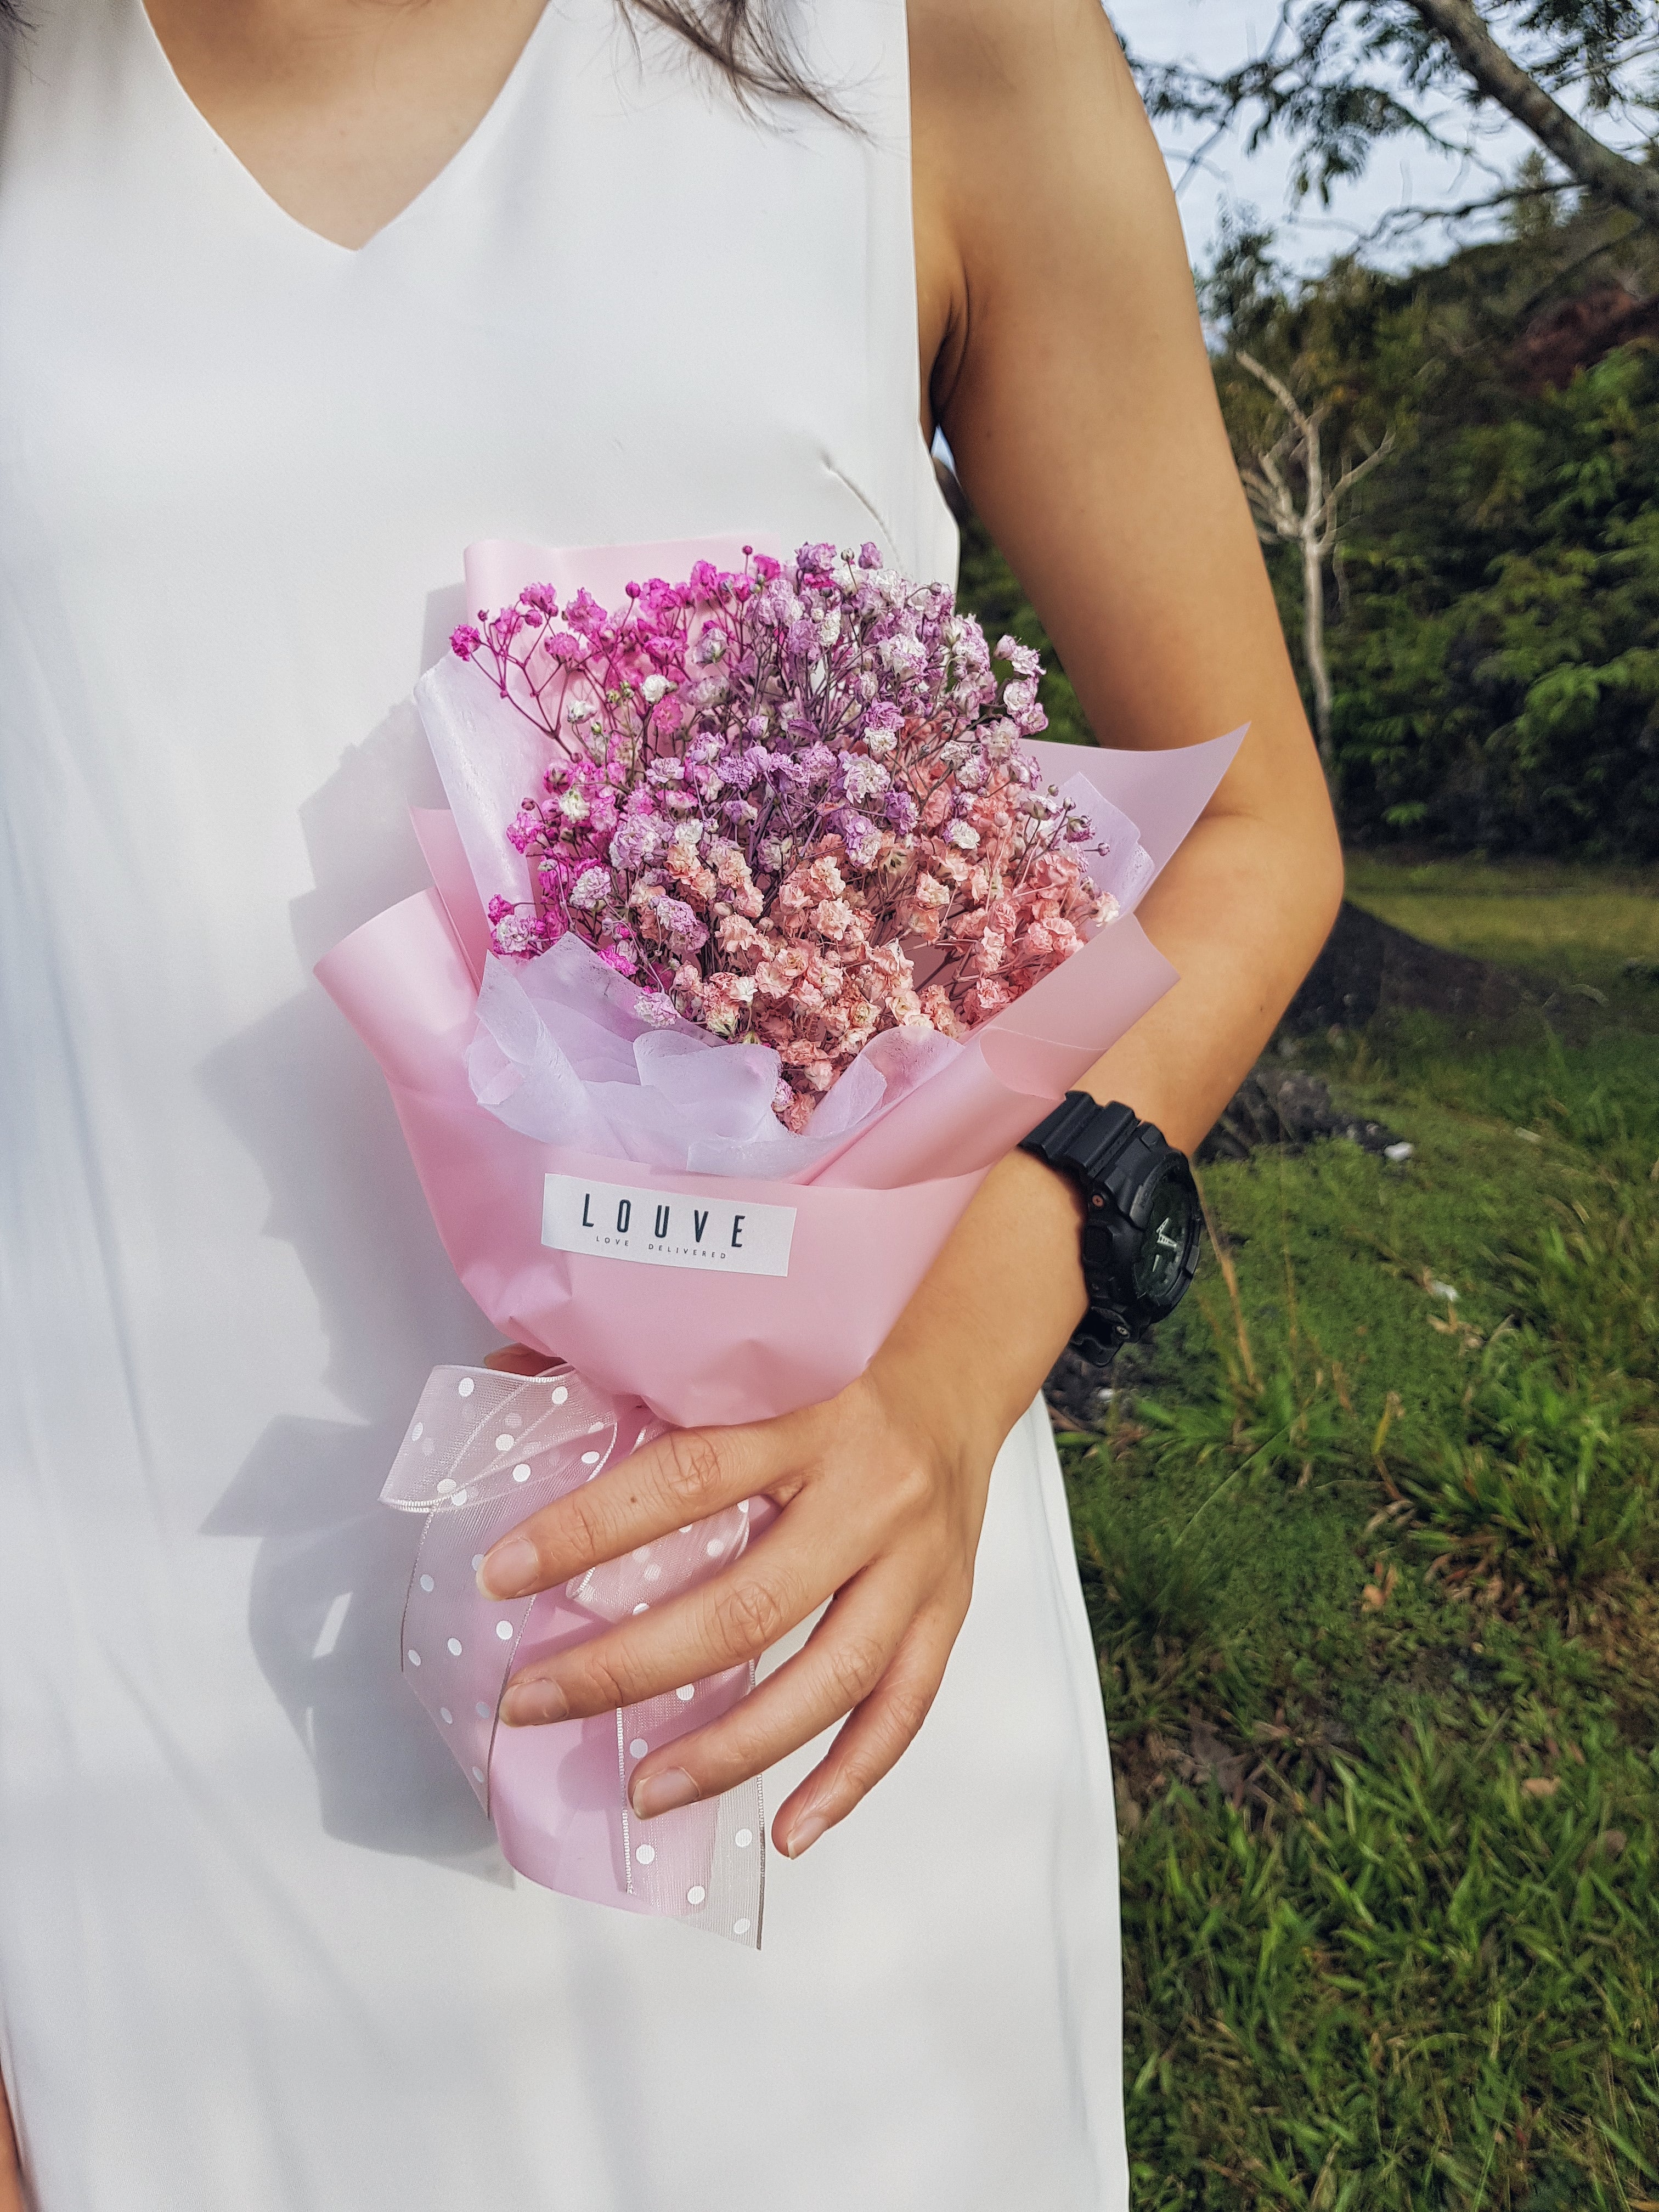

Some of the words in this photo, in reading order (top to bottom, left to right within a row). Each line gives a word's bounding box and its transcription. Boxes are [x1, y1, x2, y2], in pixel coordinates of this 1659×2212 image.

[582, 1193, 746, 1248] LOUVE
[596, 1236, 629, 1246] LOVE
[648, 1243, 726, 1259] DELIVERED
